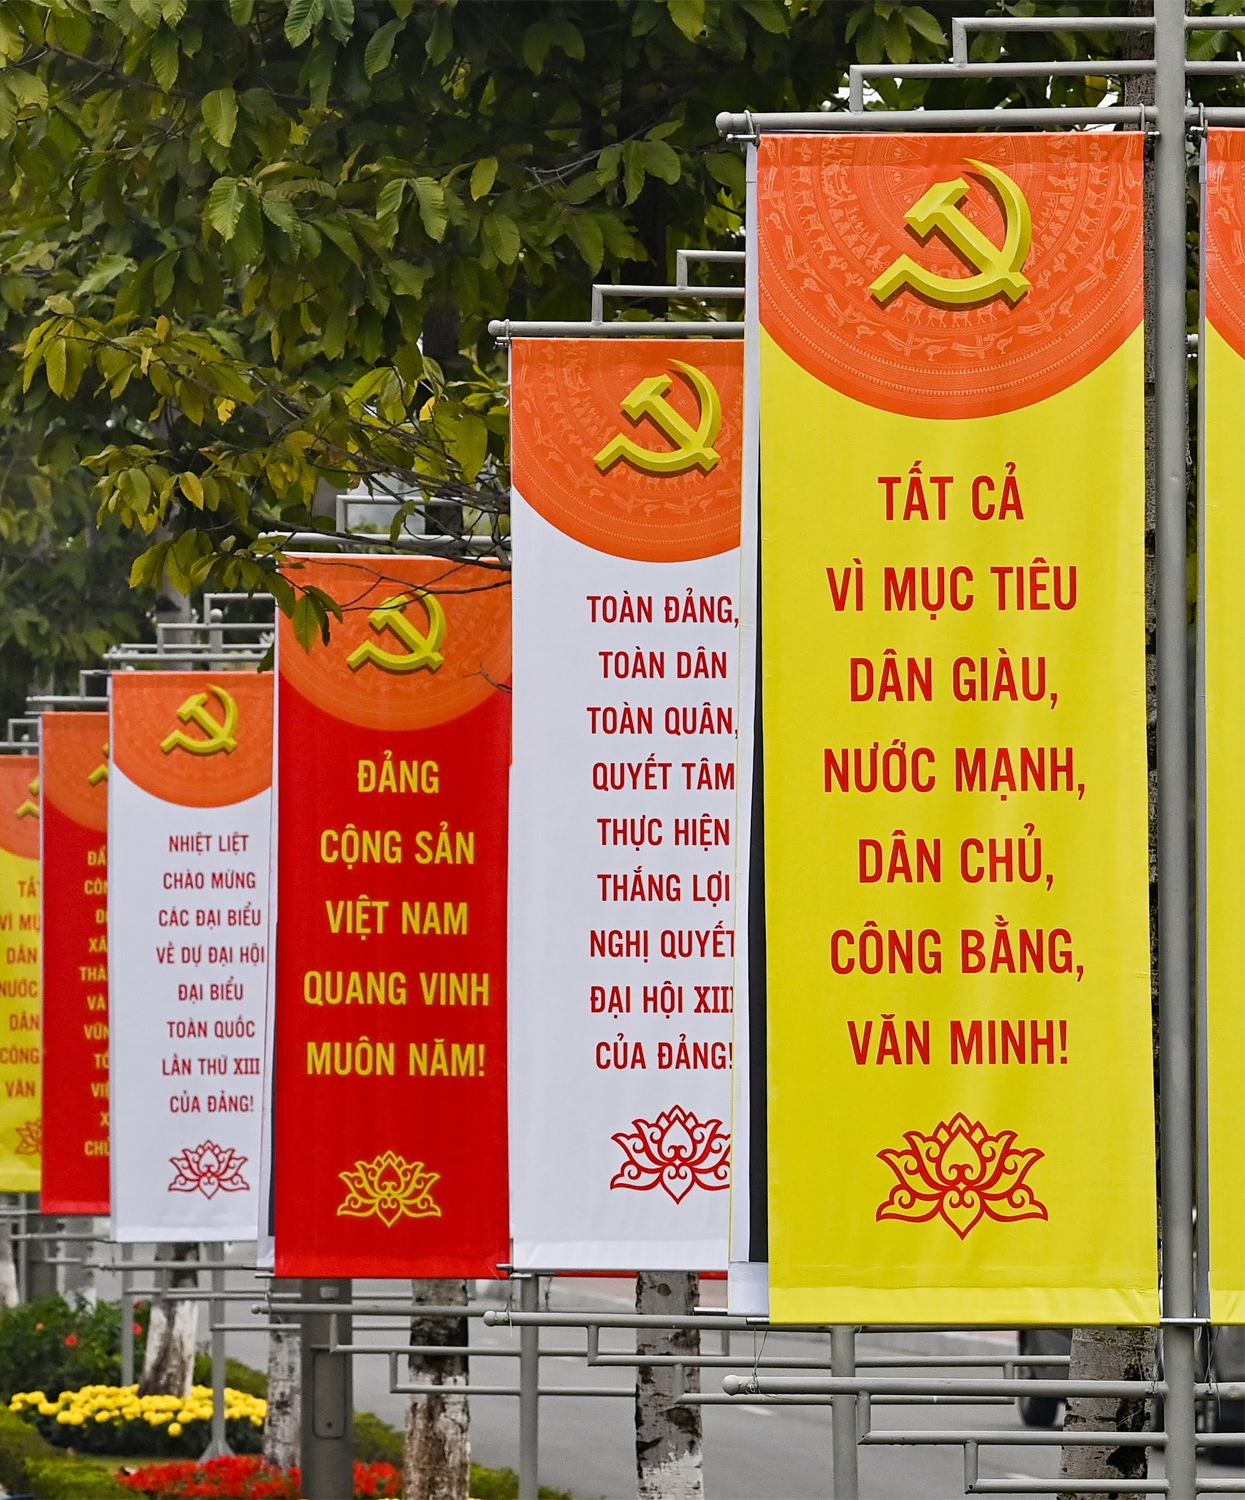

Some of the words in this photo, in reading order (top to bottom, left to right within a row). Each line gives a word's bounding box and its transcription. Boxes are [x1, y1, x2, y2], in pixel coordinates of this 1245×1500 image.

[878, 461, 953, 520] TẤT
[972, 462, 1024, 520] CẢ
[827, 558, 863, 611] VÌ
[885, 566, 973, 620] MỤC
[991, 557, 1076, 610] TIÊU
[587, 591, 653, 623] TOÀN
[664, 588, 739, 628] ĐẢNG,
[599, 646, 665, 679] TOÀN
[677, 646, 727, 679] DÂN
[851, 649, 932, 701] DÂN
[953, 648, 1057, 709] GIÀU,
[587, 702, 653, 734] TOÀN
[665, 702, 738, 739] QUÂN,
[358, 750, 438, 793] ĐẢNG
[593, 754, 672, 791] QUYẾT
[682, 758, 735, 790] TÂM
[825, 739, 935, 792] NƯỚC
[956, 748, 1084, 801] MẠNH,
[169, 833, 212, 855] NHIỆT
[219, 833, 248, 854] LIỆT
[321, 824, 401, 869] CỘNG
[415, 822, 473, 864] SẢN
[597, 816, 663, 851] THỰC
[675, 813, 730, 851] HIỆN
[859, 830, 940, 883] DÂN
[961, 823, 1053, 891] CHỦ,
[164, 870, 205, 890] CHÀO
[211, 869, 256, 889] MỪNG
[598, 866, 681, 902] THẮNG
[693, 871, 730, 907] LỢI
[159, 907, 189, 926] CÁC
[196, 910, 221, 929] ĐẠI
[228, 902, 261, 926] BIỂU
[326, 895, 389, 940] VIỆT
[402, 902, 467, 934] NAM
[6, 944, 37, 964] DÂN
[157, 941, 174, 964] VỀ
[182, 944, 202, 966] DỰ
[208, 946, 233, 965] ĐẠI
[240, 943, 265, 966] HỘI
[590, 930, 649, 963] NGHỊ
[661, 920, 735, 959] QUYẾT
[831, 921, 941, 974] CÔNG
[962, 915, 1083, 980] BẰNG,
[87, 992, 106, 1011] VÀ
[178, 984, 203, 1003] ĐẠI
[210, 977, 244, 1000] BIỂU
[304, 971, 406, 1005] QUANG
[420, 973, 488, 1005] VINH
[590, 986, 631, 1018] ĐẠI
[643, 980, 683, 1019] HỘI
[168, 1019, 208, 1038] TOÀN
[214, 1015, 255, 1038] QUỐC
[848, 1014, 929, 1065] VĂN
[951, 1020, 1067, 1064] MINH!
[0, 1043, 39, 1064] CÔNG
[162, 1053, 192, 1076] LẦN
[199, 1055, 228, 1075] THỨ
[234, 1058, 260, 1075] XIII
[308, 1036, 394, 1075] MUÔN
[410, 1039, 484, 1076] NĂM!
[596, 1032, 647, 1070] CỦA
[658, 1034, 733, 1070] ĐẢNG!
[170, 1092, 201, 1113] CỦA
[207, 1091, 253, 1113] ĐẢNG!
